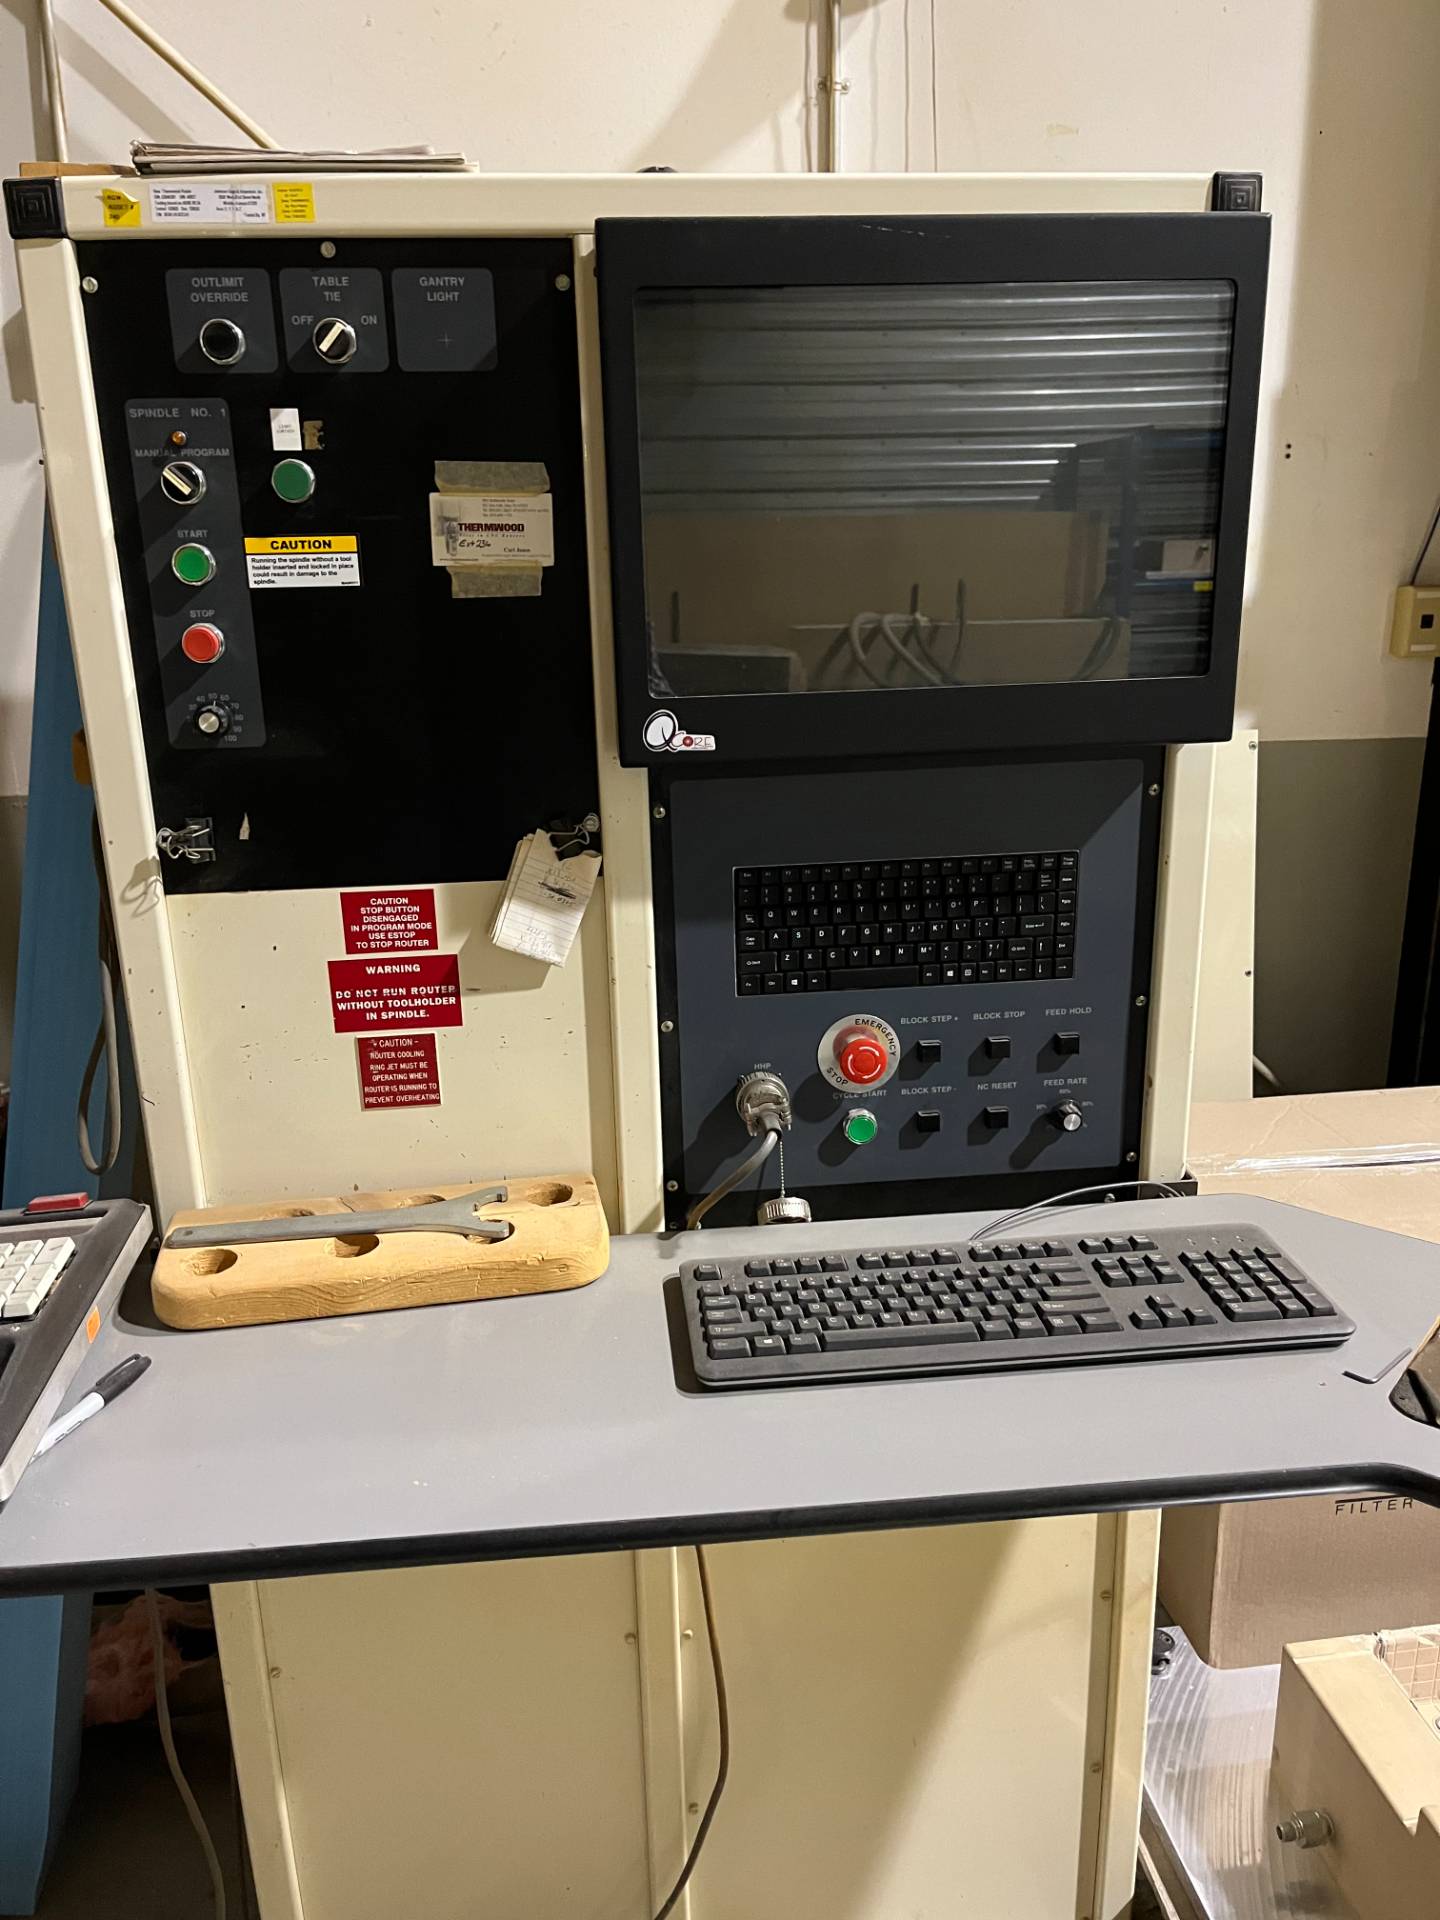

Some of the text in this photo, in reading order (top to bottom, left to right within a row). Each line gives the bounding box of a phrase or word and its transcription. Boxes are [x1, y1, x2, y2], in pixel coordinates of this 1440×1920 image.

[191, 277, 244, 288] OUTLIMIT
[311, 276, 350, 287] TABLE
[419, 277, 465, 287] GANTRY
[190, 292, 248, 303] OVERRIDE
[323, 292, 341, 302] TIE
[427, 292, 460, 302] LIGHT
[291, 315, 377, 326] OFF ON
[128, 408, 226, 418] SPINDLE NO. 1
[134, 448, 230, 457] MANUAL PROGRAM
[457, 523, 525, 532] THERMWOOD
[177, 529, 208, 538] START
[270, 539, 332, 550] CAUTION
[189, 609, 215, 618] STOP
[370, 897, 409, 905] CAUTION
[360, 905, 420, 915] STOP BUTTON
[767, 910, 774, 918] Q
[813, 908, 819, 916] E
[859, 905, 864, 913] T
[950, 901, 956, 909] O
[363, 914, 419, 923] DISENGAGED
[362, 923, 405, 932] PROGRAM
[407, 922, 432, 930] MODE
[796, 931, 801, 939] S
[932, 924, 938, 932] K
[955, 923, 959, 931] L
[368, 931, 416, 940] USE ESTOP
[356, 939, 429, 949] TO STOP ROUTER
[829, 951, 836, 959] C
[365, 964, 421, 975] WARNING
[336, 985, 456, 999] DO NOT RUN ROUTER
[337, 997, 456, 1011] WITHOUT TOOLHOLDER
[366, 1009, 430, 1021] IN SPINDLE.
[973, 1011, 1025, 1020] BLOCK STOP
[1045, 1007, 1092, 1016] FEED HOLD
[900, 1015, 929, 1025] BLOCK
[931, 1015, 952, 1023] STEP
[855, 1018, 897, 1056] EMERGENCY
[379, 1038, 413, 1048] CAUTION
[370, 1050, 425, 1059] ROUTER COOLING
[419, 1061, 428, 1069] BE
[754, 1063, 771, 1071] HHP
[372, 1072, 428, 1082] OPERATING WHEN
[826, 1067, 849, 1086] STOP
[364, 1085, 390, 1093] ROUTER
[391, 1084, 397, 1092] IS
[399, 1083, 428, 1091] RUNNING
[977, 1081, 1017, 1091] NC RESET
[1043, 1079, 1065, 1087] FEED
[901, 1086, 928, 1095] BLOCK
[931, 1085, 952, 1094] STEP
[365, 1093, 440, 1104] PREVENT OVERHEATING
[1335, 1498, 1413, 1516] FILTER
